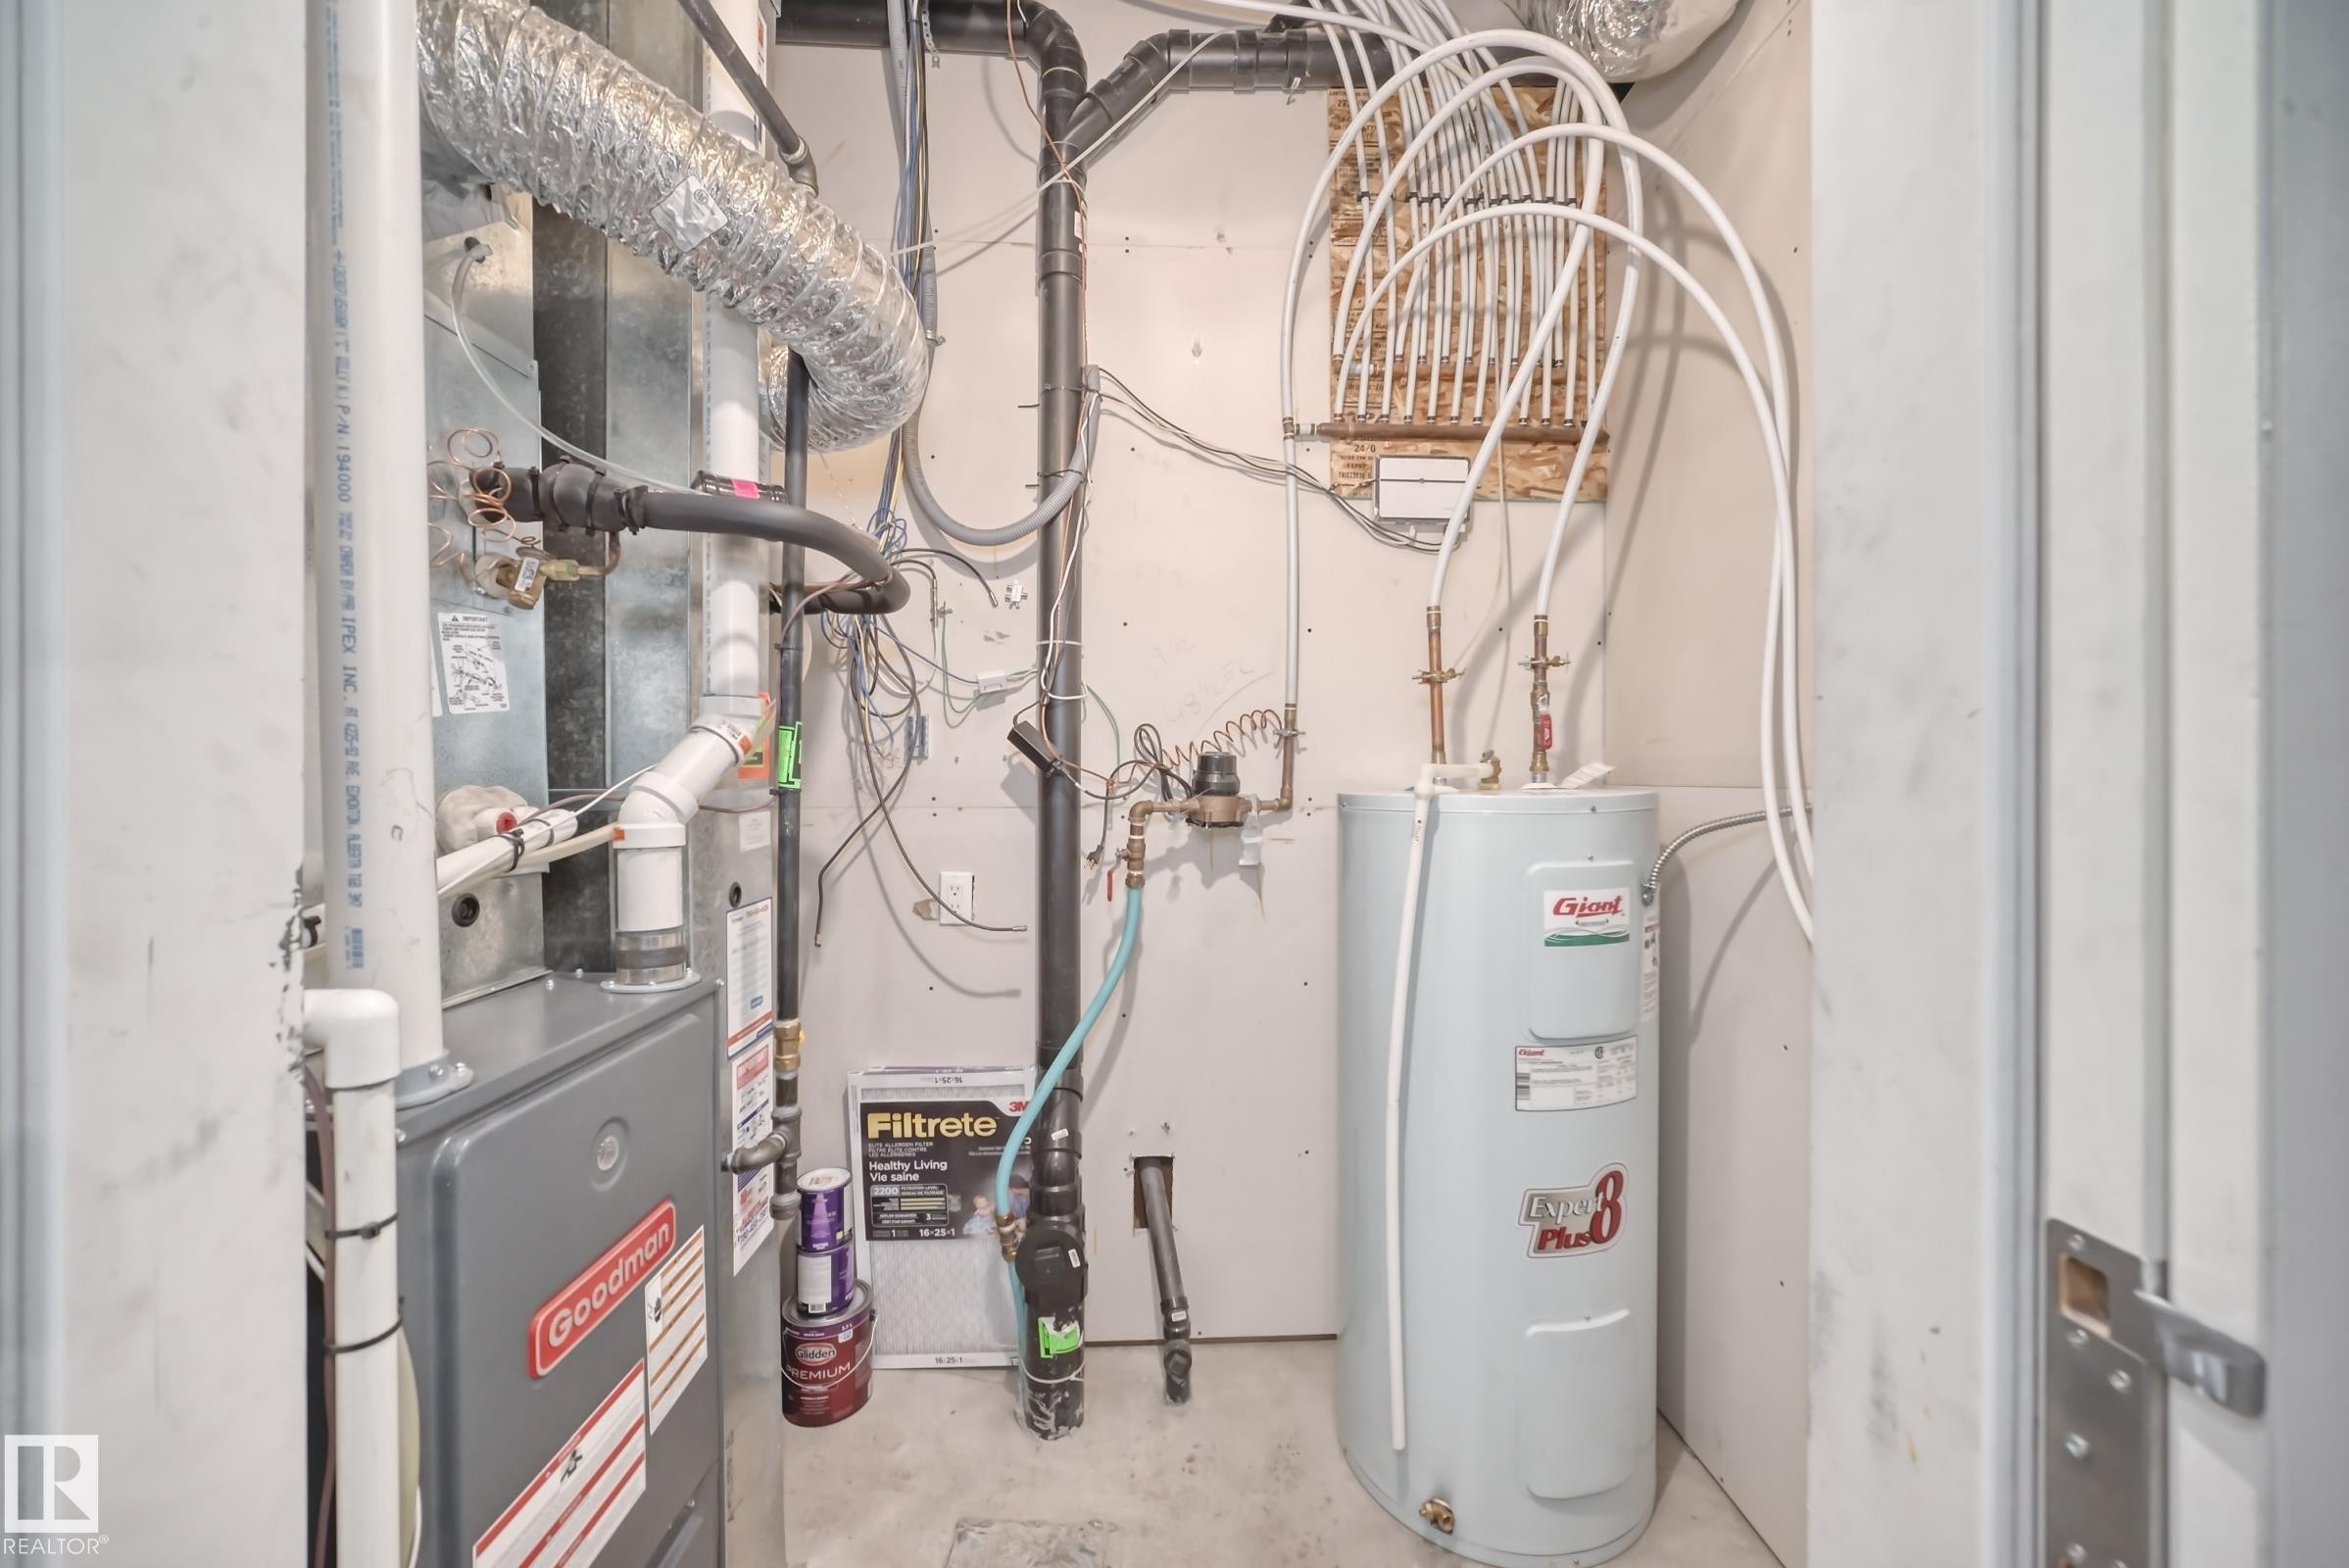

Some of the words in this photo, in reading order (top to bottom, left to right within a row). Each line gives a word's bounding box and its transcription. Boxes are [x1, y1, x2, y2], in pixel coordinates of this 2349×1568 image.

[337, 446, 353, 503] 194000
[341, 616, 357, 655] IPEX
[343, 664, 358, 702] INC.
[1553, 895, 1624, 918] Giant
[867, 1112, 997, 1139] Filtrete
[869, 1160, 911, 1172] Healthy
[913, 1159, 948, 1171] Living
[869, 1172, 888, 1182] Vie
[890, 1171, 920, 1182] saine
[873, 1187, 899, 1196] 2200
[1529, 1192, 1605, 1225] Expert
[1590, 1169, 1624, 1245] 8
[1537, 1226, 1592, 1250] Plus
[549, 1222, 669, 1348] Goodman
[796, 1348, 836, 1360] Glidden
[785, 1361, 851, 1381] PREMIUM
